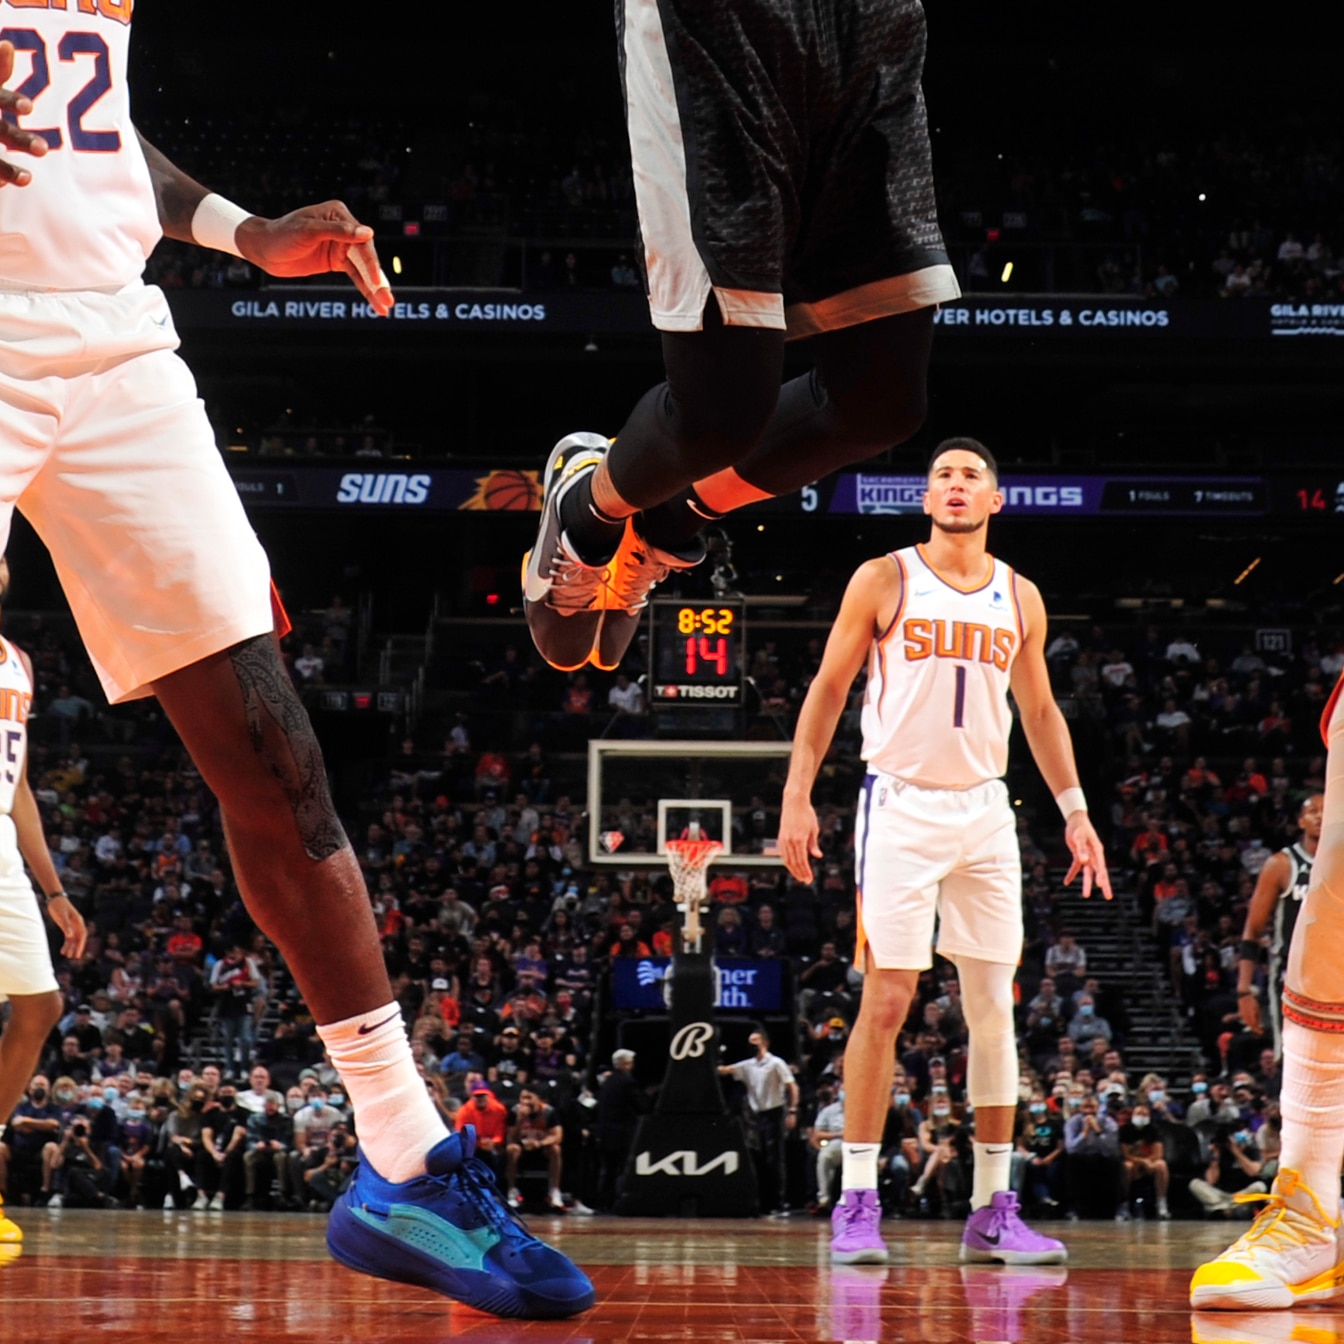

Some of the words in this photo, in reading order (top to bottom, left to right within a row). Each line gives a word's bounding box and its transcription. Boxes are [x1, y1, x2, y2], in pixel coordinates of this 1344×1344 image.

[231, 301, 280, 318] GILA
[284, 301, 347, 318] RIVER
[435, 304, 449, 319] &
[455, 303, 546, 320] CASINOS
[975, 309, 1054, 326] HOTELS
[1058, 310, 1073, 326] &
[1078, 310, 1169, 327] CASINOS
[1270, 304, 1309, 318] GILA
[336, 473, 432, 505] SUNS
[1001, 486, 1083, 506] INGS
[1297, 488, 1327, 510] 14
[678, 608, 734, 635] 8:52
[686, 637, 727, 675] 14
[903, 618, 1016, 673] SUNS
[677, 686, 739, 699] TISSOT
[953, 665, 966, 728] 1
